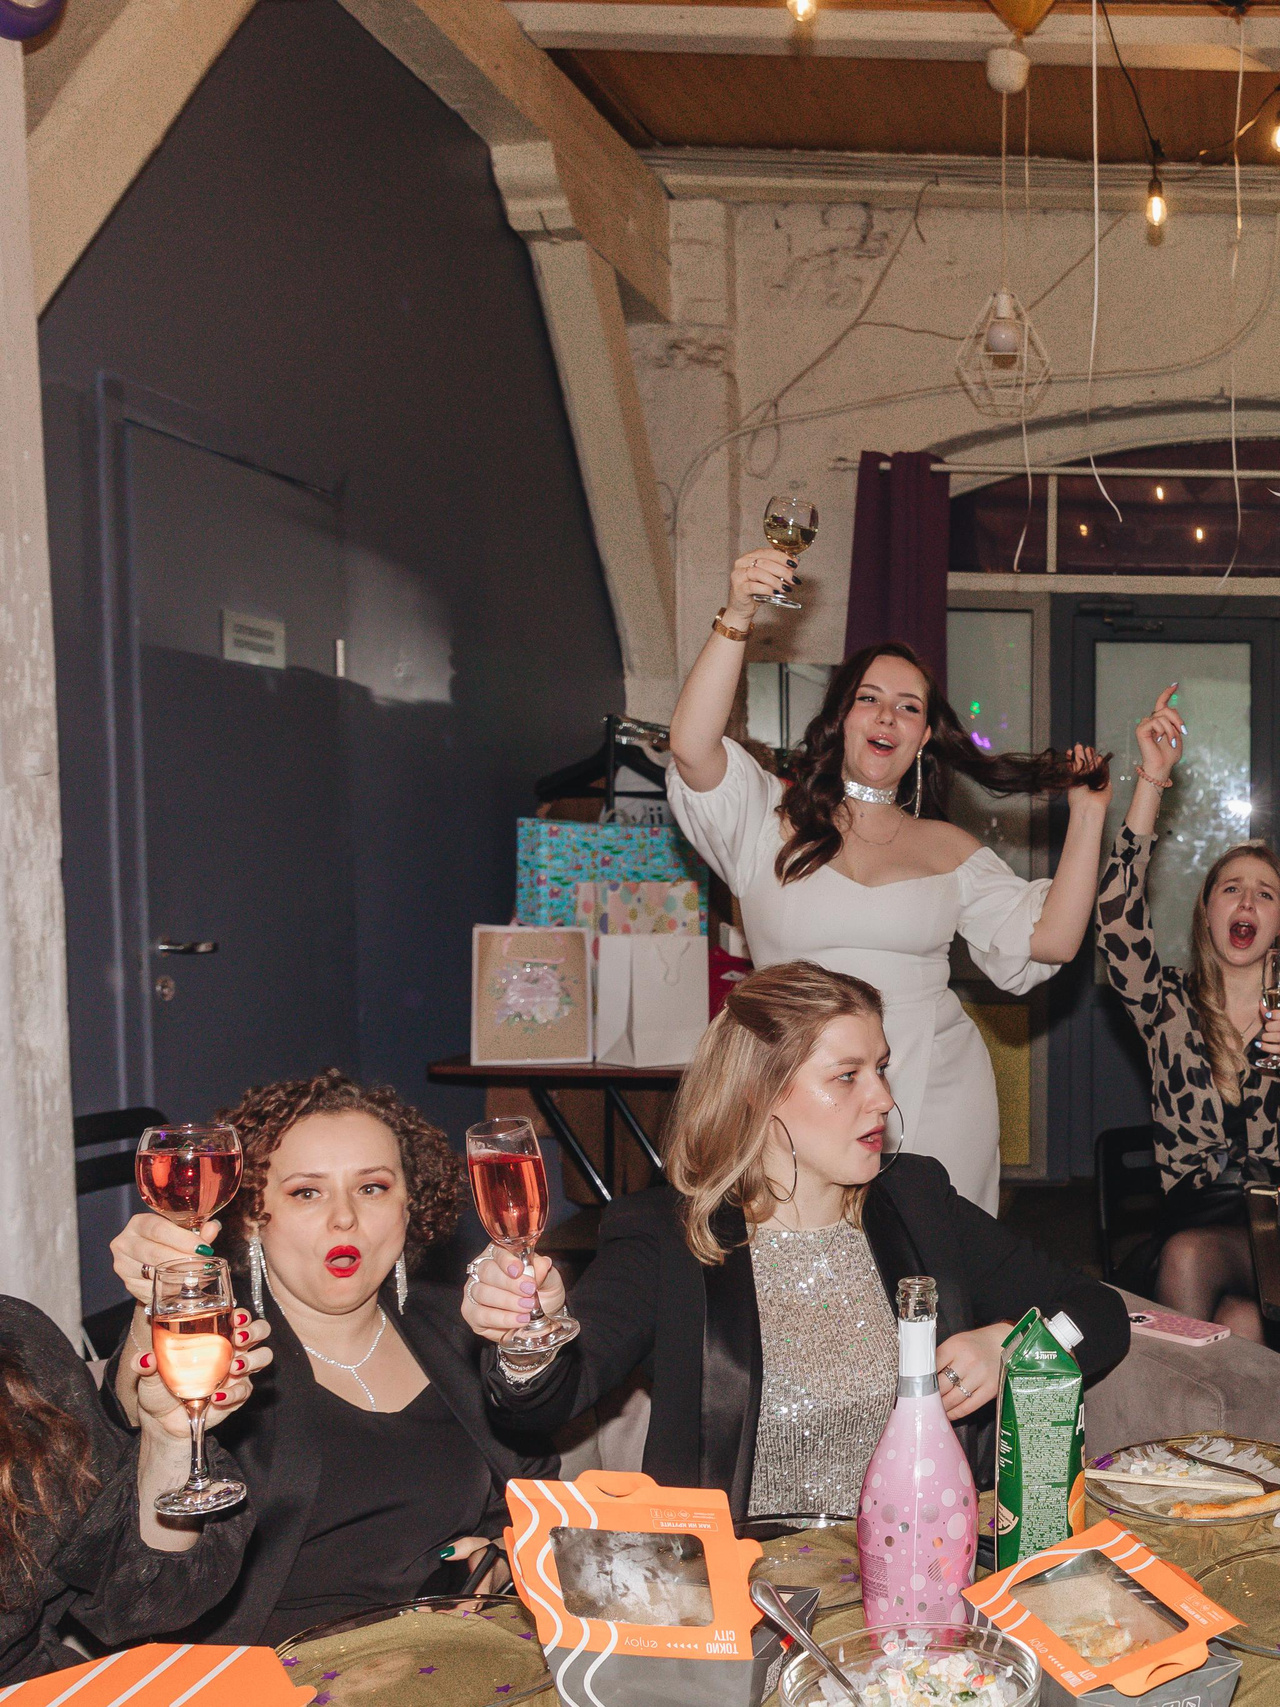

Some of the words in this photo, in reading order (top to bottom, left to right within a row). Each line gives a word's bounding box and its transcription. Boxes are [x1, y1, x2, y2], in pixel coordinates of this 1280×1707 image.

[713, 1630, 736, 1641] CITY
[624, 1636, 658, 1650] enjoy
[1028, 1637, 1048, 1654] enjoy
